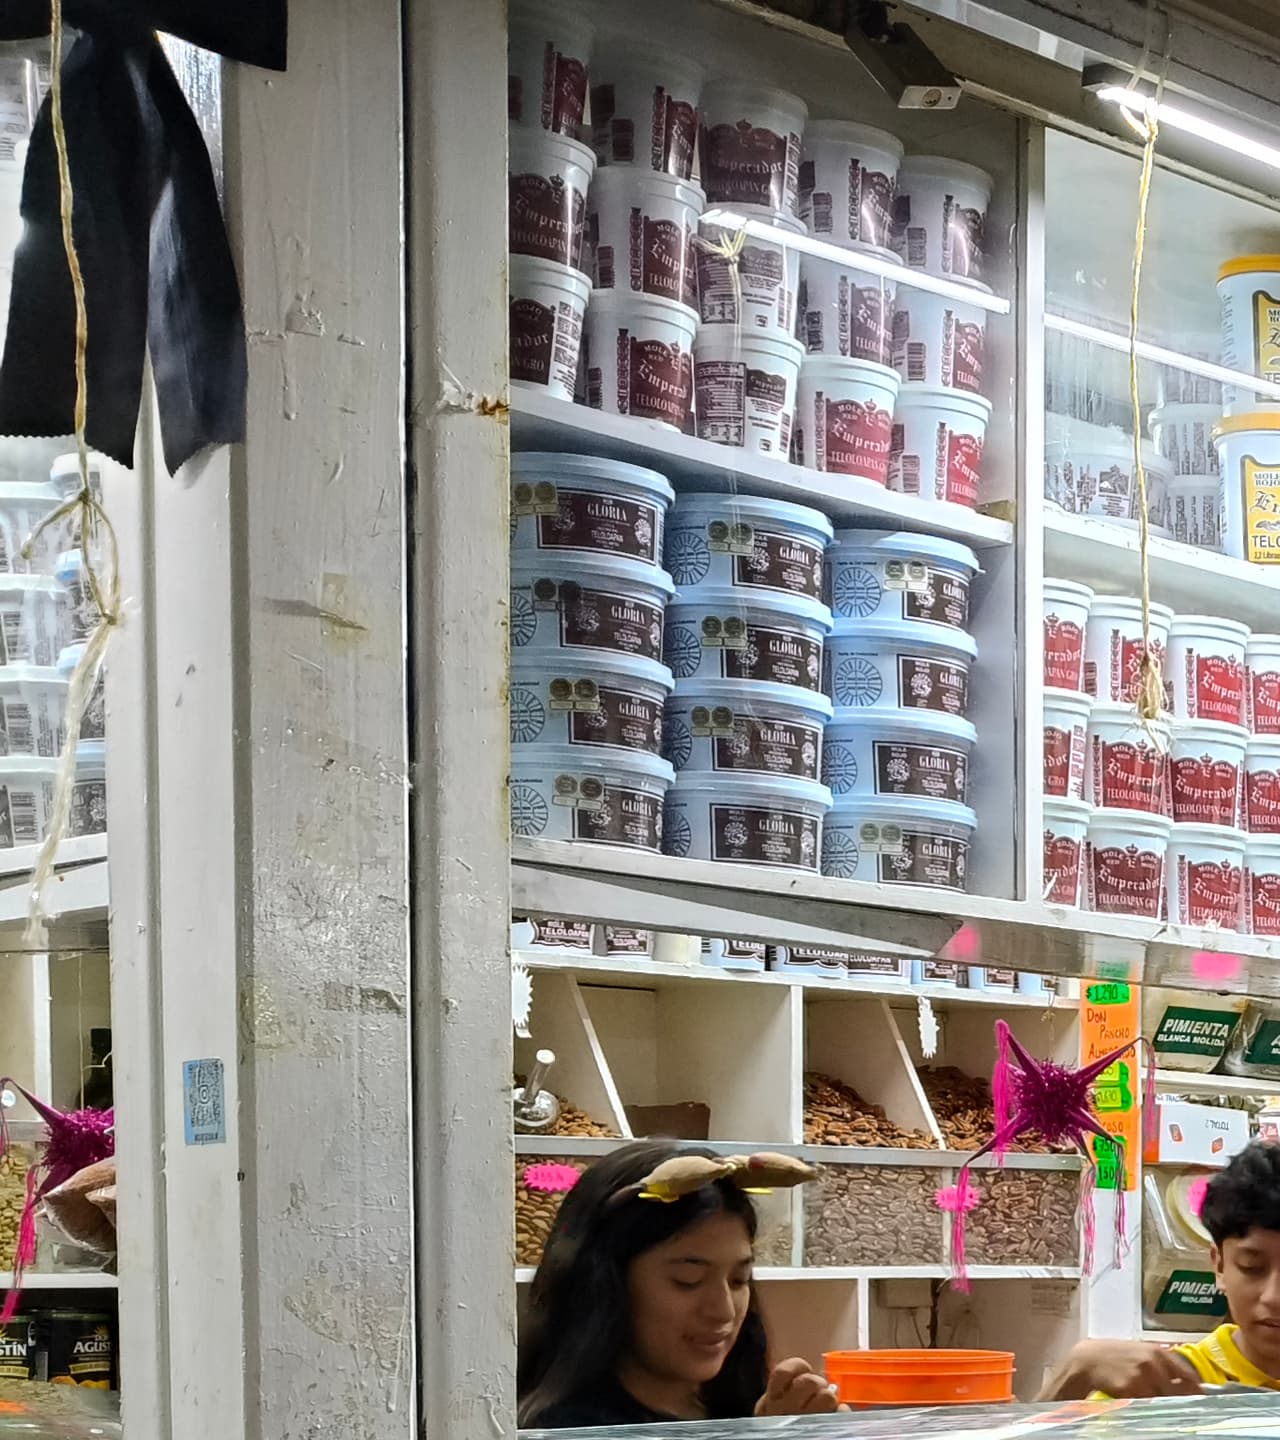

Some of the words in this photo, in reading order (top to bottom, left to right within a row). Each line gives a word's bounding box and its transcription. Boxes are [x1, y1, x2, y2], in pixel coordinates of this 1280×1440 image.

[587, 502, 628, 521] GLORIA
[779, 546, 811, 566] GLORIA
[611, 606, 647, 625] GLORIA
[618, 701, 651, 721] GLORIA
[759, 728, 797, 745] GLORIA
[918, 755, 952, 771] GLORIA
[1174, 774, 1237, 800] Emperador
[758, 818, 795, 834] GLORIA
[1097, 863, 1160, 891] Emperador
[1087, 1008, 1107, 1023] DON
[1162, 1018, 1230, 1038] PIMIENTA
[1157, 1033, 1192, 1045] BLANCA
[1193, 1035, 1226, 1048] MOLIDA
[1169, 1281, 1223, 1296] PIMIEN
